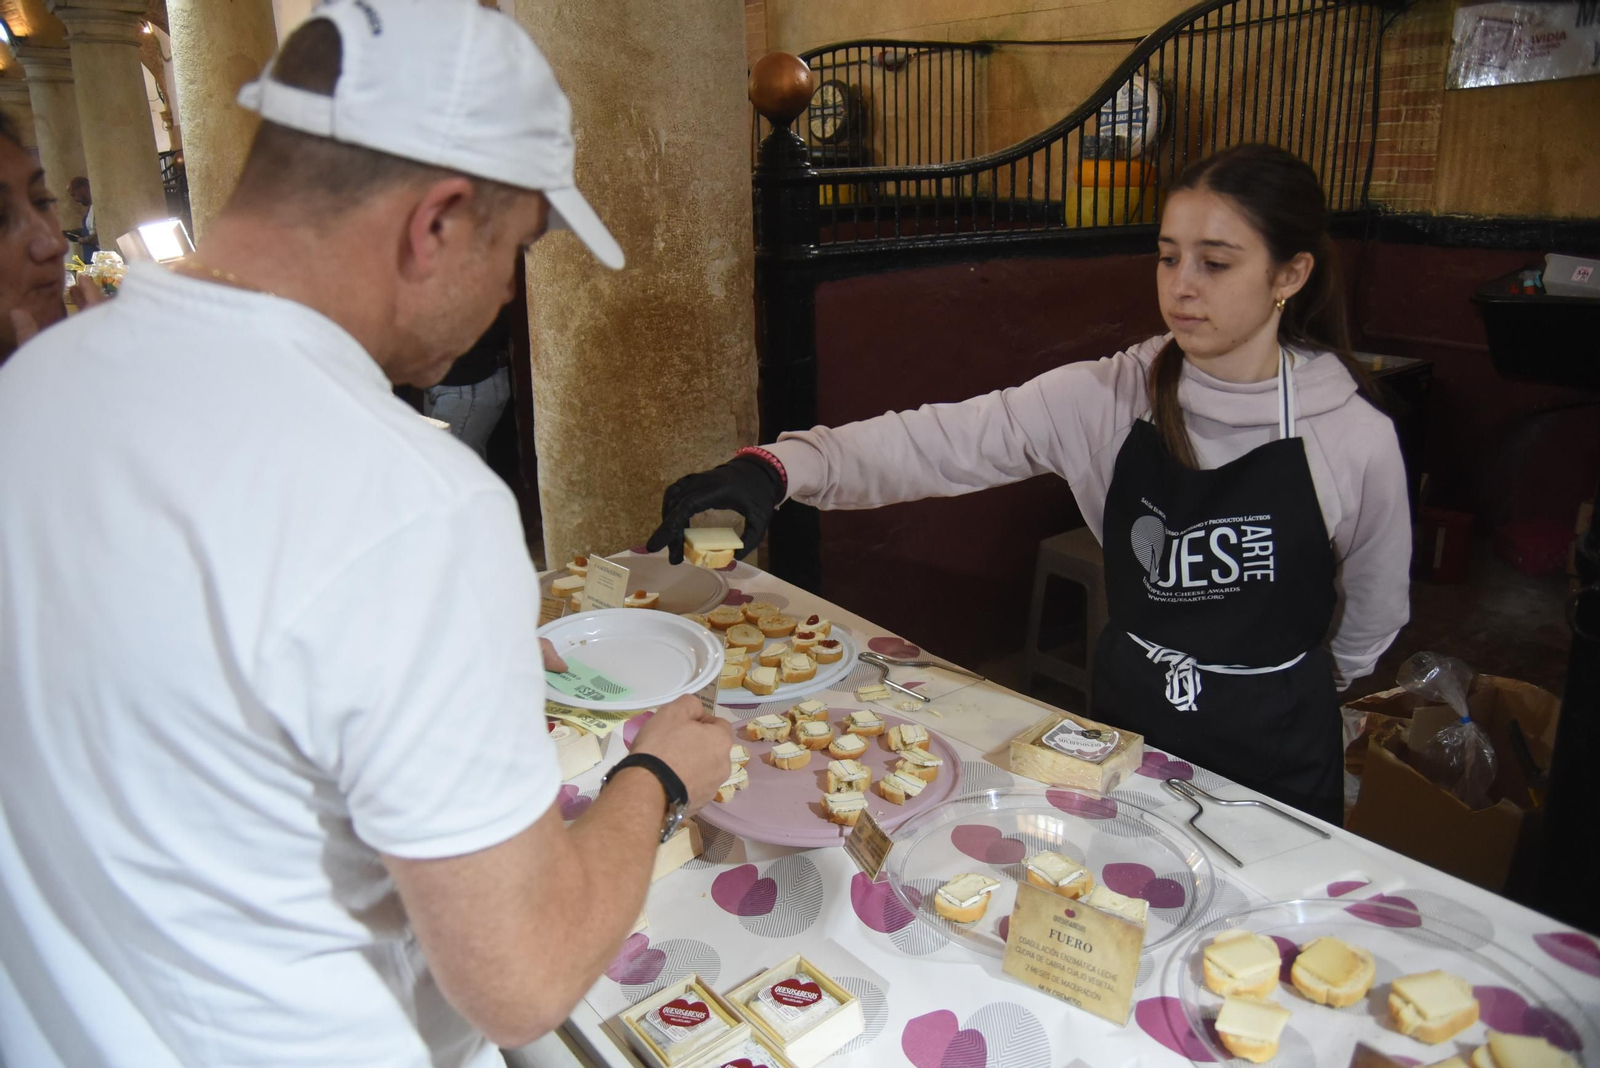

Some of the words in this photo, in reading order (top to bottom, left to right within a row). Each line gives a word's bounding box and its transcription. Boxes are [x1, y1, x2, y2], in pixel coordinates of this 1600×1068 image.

[1209, 516, 1244, 525] PRODUCTOS
[1244, 514, 1271, 522] LÁCTEOS
[1241, 525, 1274, 582] ARTE
[1142, 576, 1173, 597] EUROPEAN
[1174, 588, 1206, 597] CHEESE
[1207, 586, 1241, 595] AWARDS
[1049, 928, 1093, 954] FUERO
[1018, 936, 1059, 958] COAGULACIÓN
[1060, 951, 1096, 973] ENZIMÁTICA
[1097, 967, 1119, 982] LECHE
[1036, 953, 1045, 963] DE
[1045, 956, 1066, 972] CABRA
[1067, 966, 1087, 981] CUAJO
[774, 985, 819, 1000] QUESOS&BESOS
[1030, 966, 1051, 980] MESES
[1051, 974, 1060, 984] DE
[1061, 977, 1101, 1002] MADURACIÓN
[662, 1006, 707, 1019] QUESOS&BESOS
